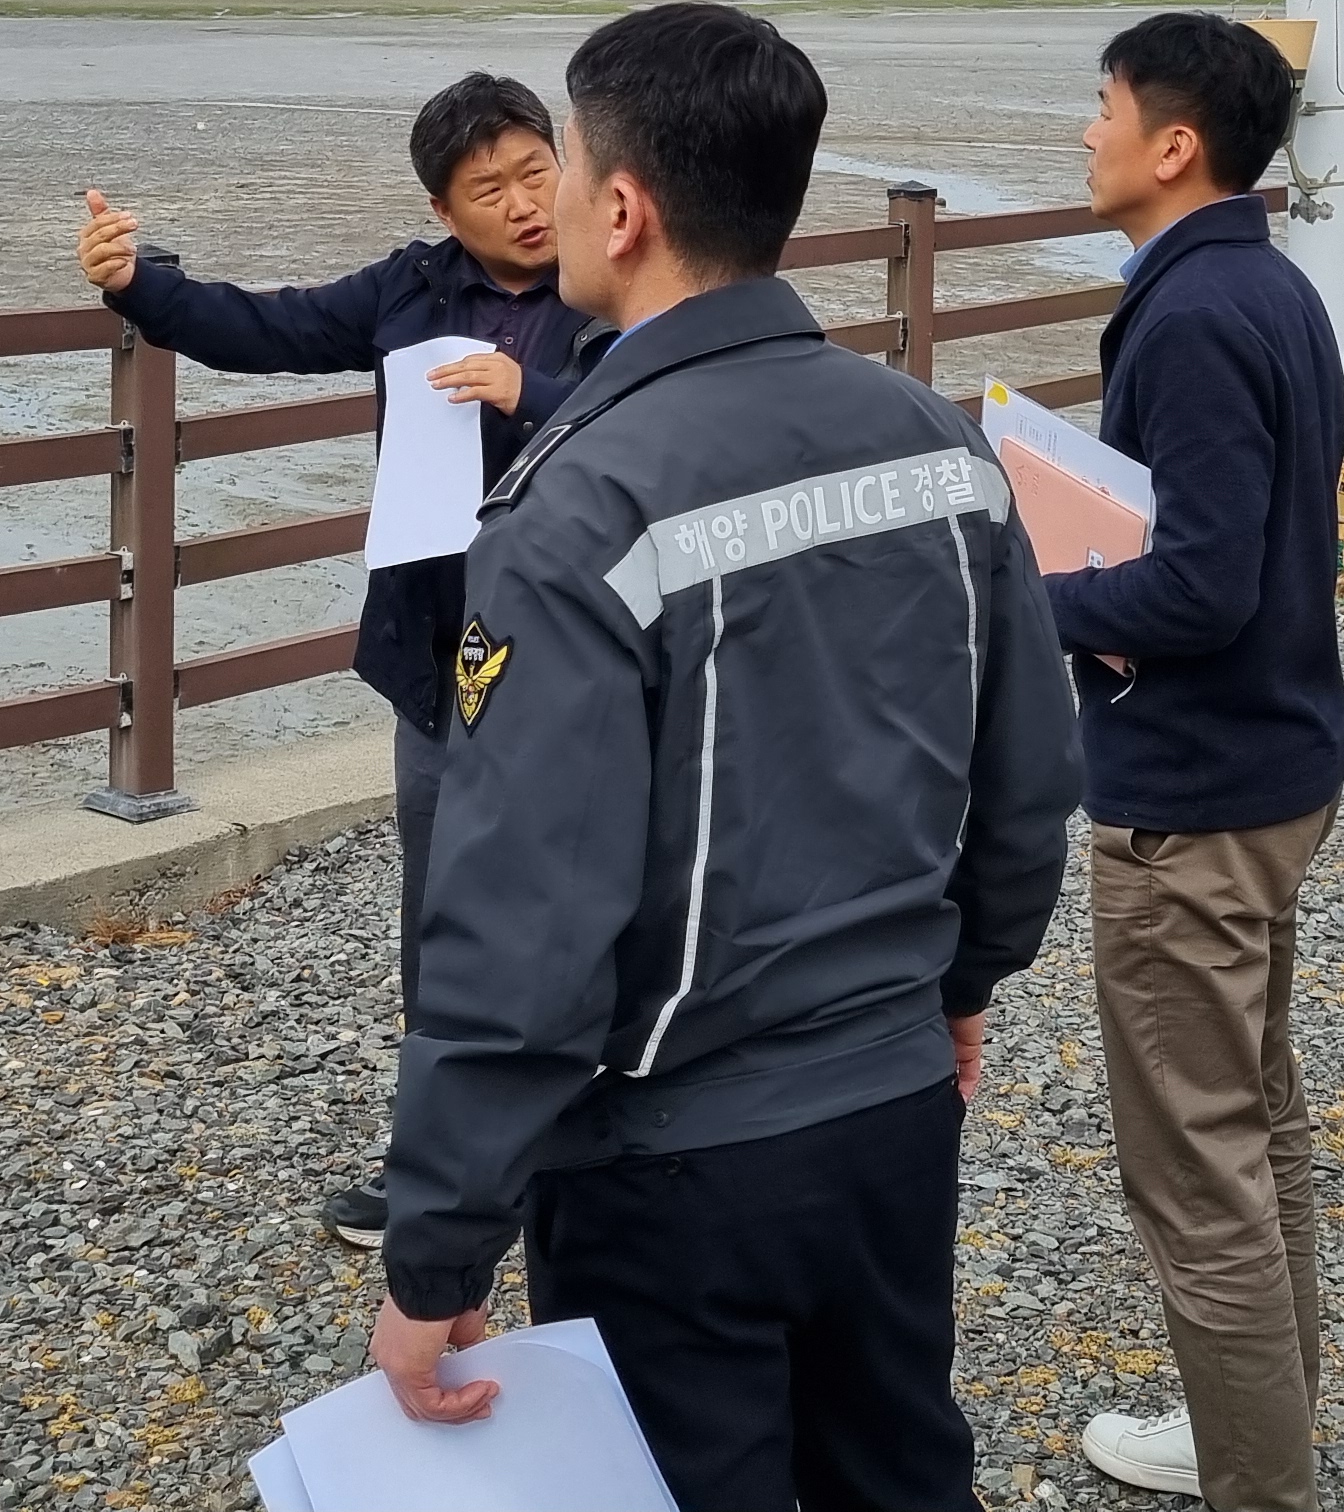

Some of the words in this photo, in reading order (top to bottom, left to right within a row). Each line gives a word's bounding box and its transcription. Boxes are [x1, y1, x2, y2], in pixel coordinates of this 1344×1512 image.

[674, 509, 748, 570] 해양
[760, 470, 906, 551] POLICE
[910, 456, 976, 513] 경찰
